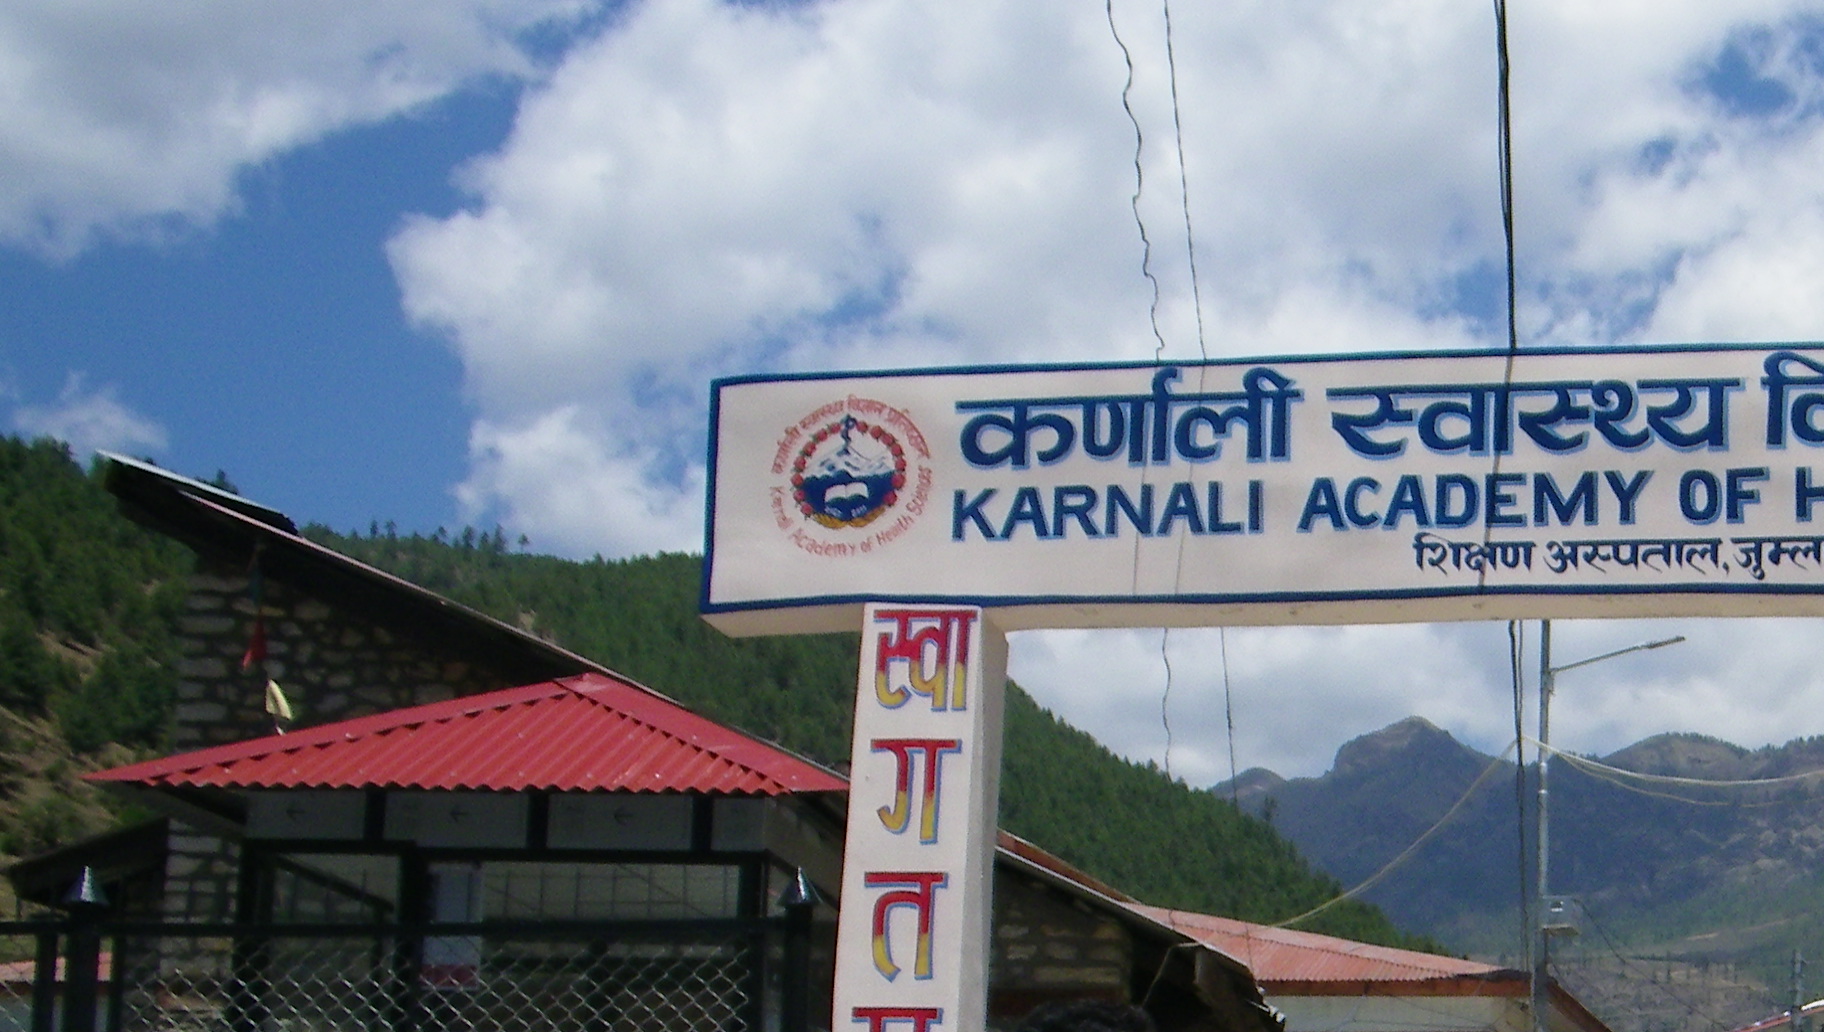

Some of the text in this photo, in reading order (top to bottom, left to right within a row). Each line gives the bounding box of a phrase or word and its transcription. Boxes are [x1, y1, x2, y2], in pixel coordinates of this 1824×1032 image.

[956, 366, 1304, 468] कर्णाली
[1327, 376, 1742, 463] स्वास्थ्य
[952, 480, 1265, 543] KARNALI
[1296, 471, 1654, 534] ACADEMY
[1679, 466, 1772, 526] OF
[1413, 532, 1537, 575] शिक्षण
